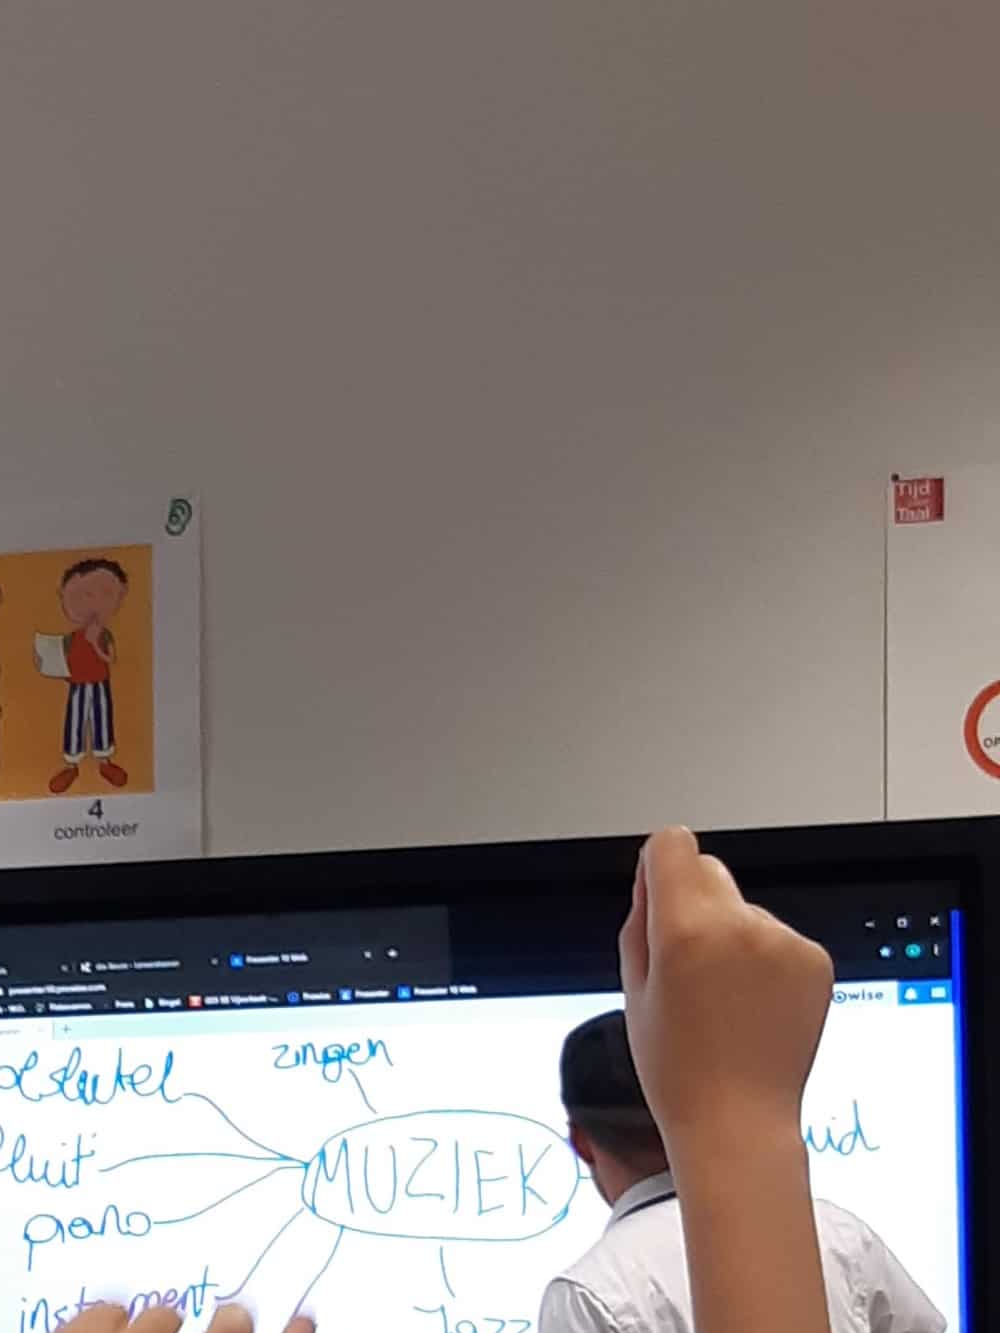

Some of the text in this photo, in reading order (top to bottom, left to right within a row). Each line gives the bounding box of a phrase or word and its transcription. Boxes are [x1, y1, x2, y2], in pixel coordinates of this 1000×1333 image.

[88, 799, 104, 819] 4
[53, 820, 140, 841] controleer
[833, 989, 884, 1004] owise
[271, 1038, 394, 1083] zingen
[311, 1137, 552, 1217] MUZIEK
